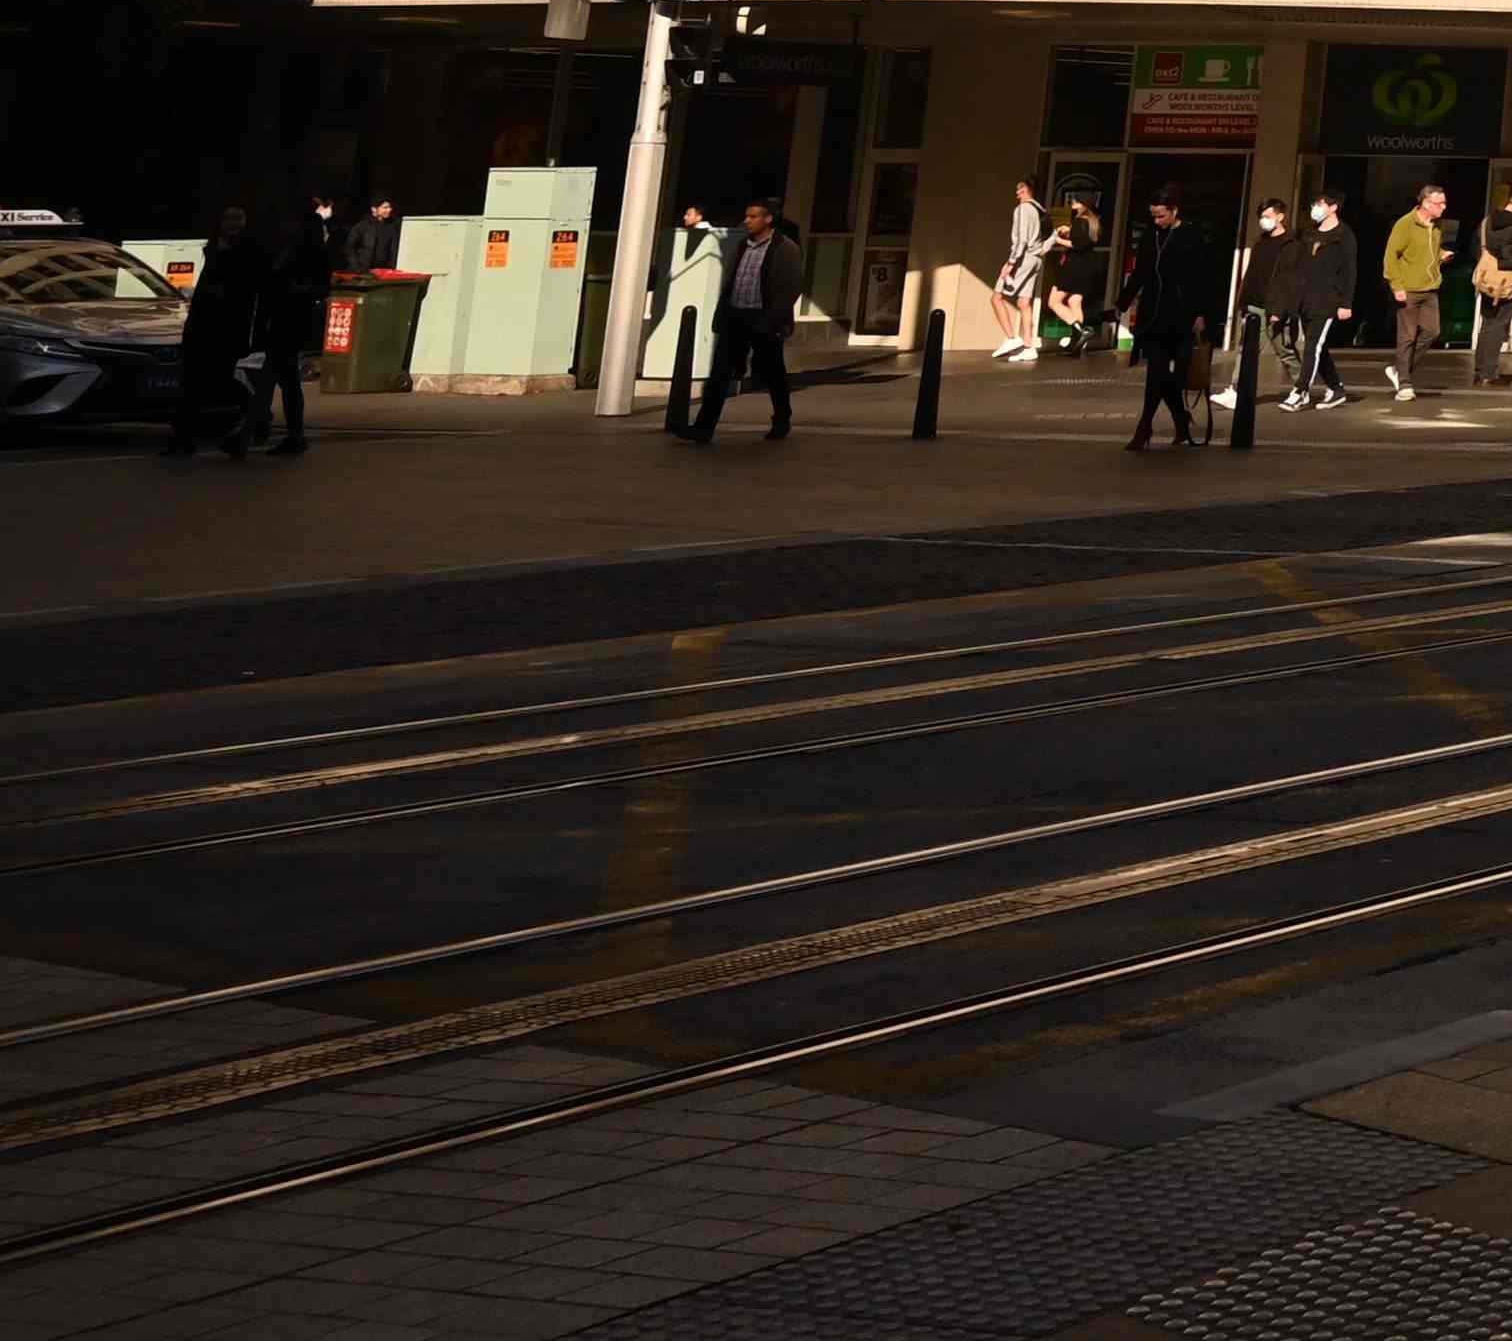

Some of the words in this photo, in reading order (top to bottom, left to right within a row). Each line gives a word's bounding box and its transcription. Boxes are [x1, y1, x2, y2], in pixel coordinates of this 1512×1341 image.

[1366, 133, 1456, 150] woolworths
[0, 212, 15, 222] XI
[16, 212, 54, 222] Service
